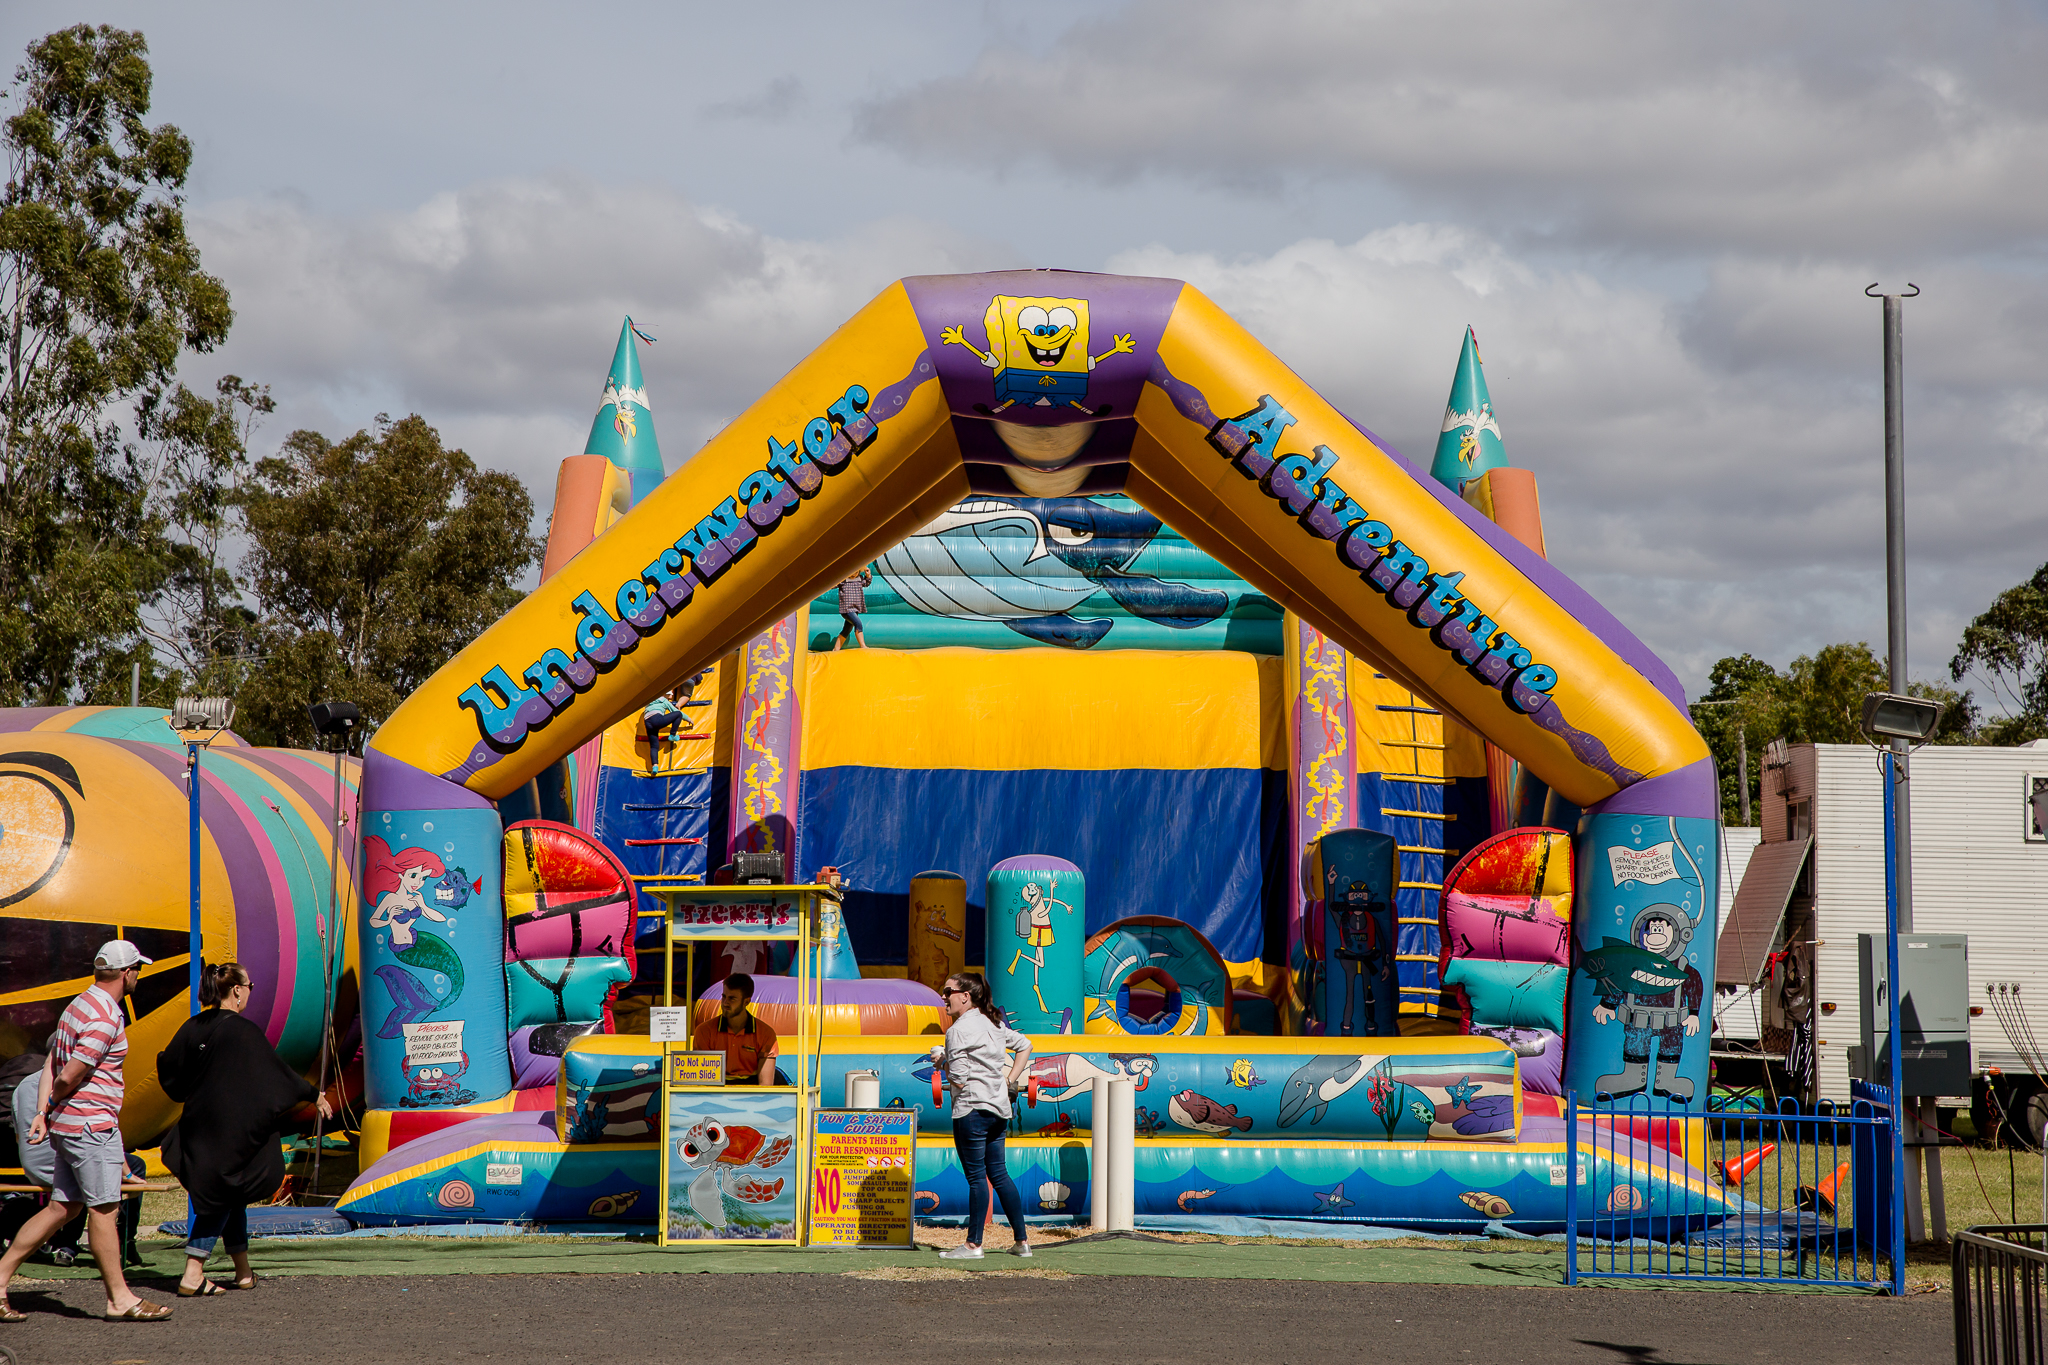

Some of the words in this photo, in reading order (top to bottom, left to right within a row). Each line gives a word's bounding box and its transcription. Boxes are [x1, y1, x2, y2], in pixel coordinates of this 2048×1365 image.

[1204, 393, 1559, 715] Adventure
[457, 384, 879, 755] Underwater
[1623, 848, 1660, 860] PLEASE
[1614, 856, 1641, 866] REMOVE
[1643, 854, 1665, 866] SHOES
[1640, 860, 1670, 872] OBJECTS
[1650, 868, 1674, 880] DRINKS
[680, 903, 791, 925] TICKETS
[416, 1024, 449, 1033] Please
[675, 1058, 685, 1067] Do
[687, 1058, 699, 1067] Not
[701, 1058, 721, 1069] Jump
[680, 1070, 697, 1079] From
[699, 1070, 716, 1079] Slide
[820, 1115, 845, 1124] FUN
[849, 1115, 860, 1124] &
[864, 1115, 908, 1125] SAFETY
[843, 1124, 884, 1134] GUIDE
[831, 1136, 867, 1144] PARENTS
[870, 1137, 888, 1145] THIS
[820, 1146, 842, 1154] YOUR
[844, 1146, 908, 1155] RESPONSIBILITY
[488, 1166, 520, 1177] BWB
[815, 1168, 841, 1214] NO
